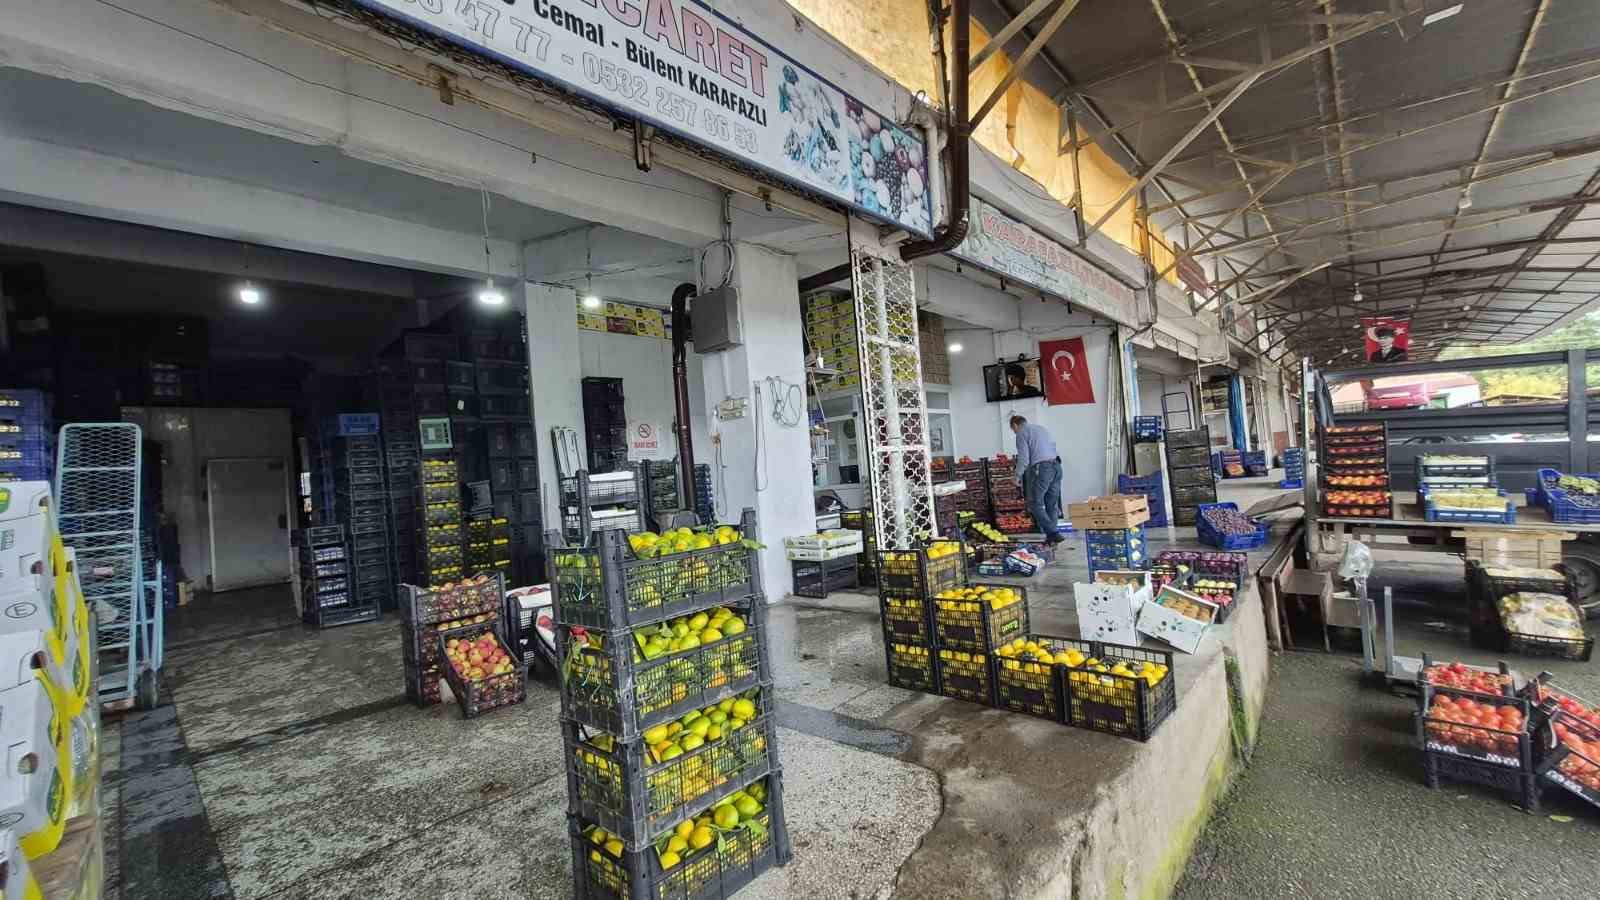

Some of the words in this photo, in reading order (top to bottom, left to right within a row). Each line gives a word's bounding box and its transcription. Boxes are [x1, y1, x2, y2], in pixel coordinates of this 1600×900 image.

[510, 16, 552, 61] 77
[583, 52, 650, 107] 0532
[656, 86, 698, 128] 257
[533, 0, 605, 47] Cemal
[625, 38, 684, 86] Bülent
[688, 70, 768, 127] KARAFAZLI
